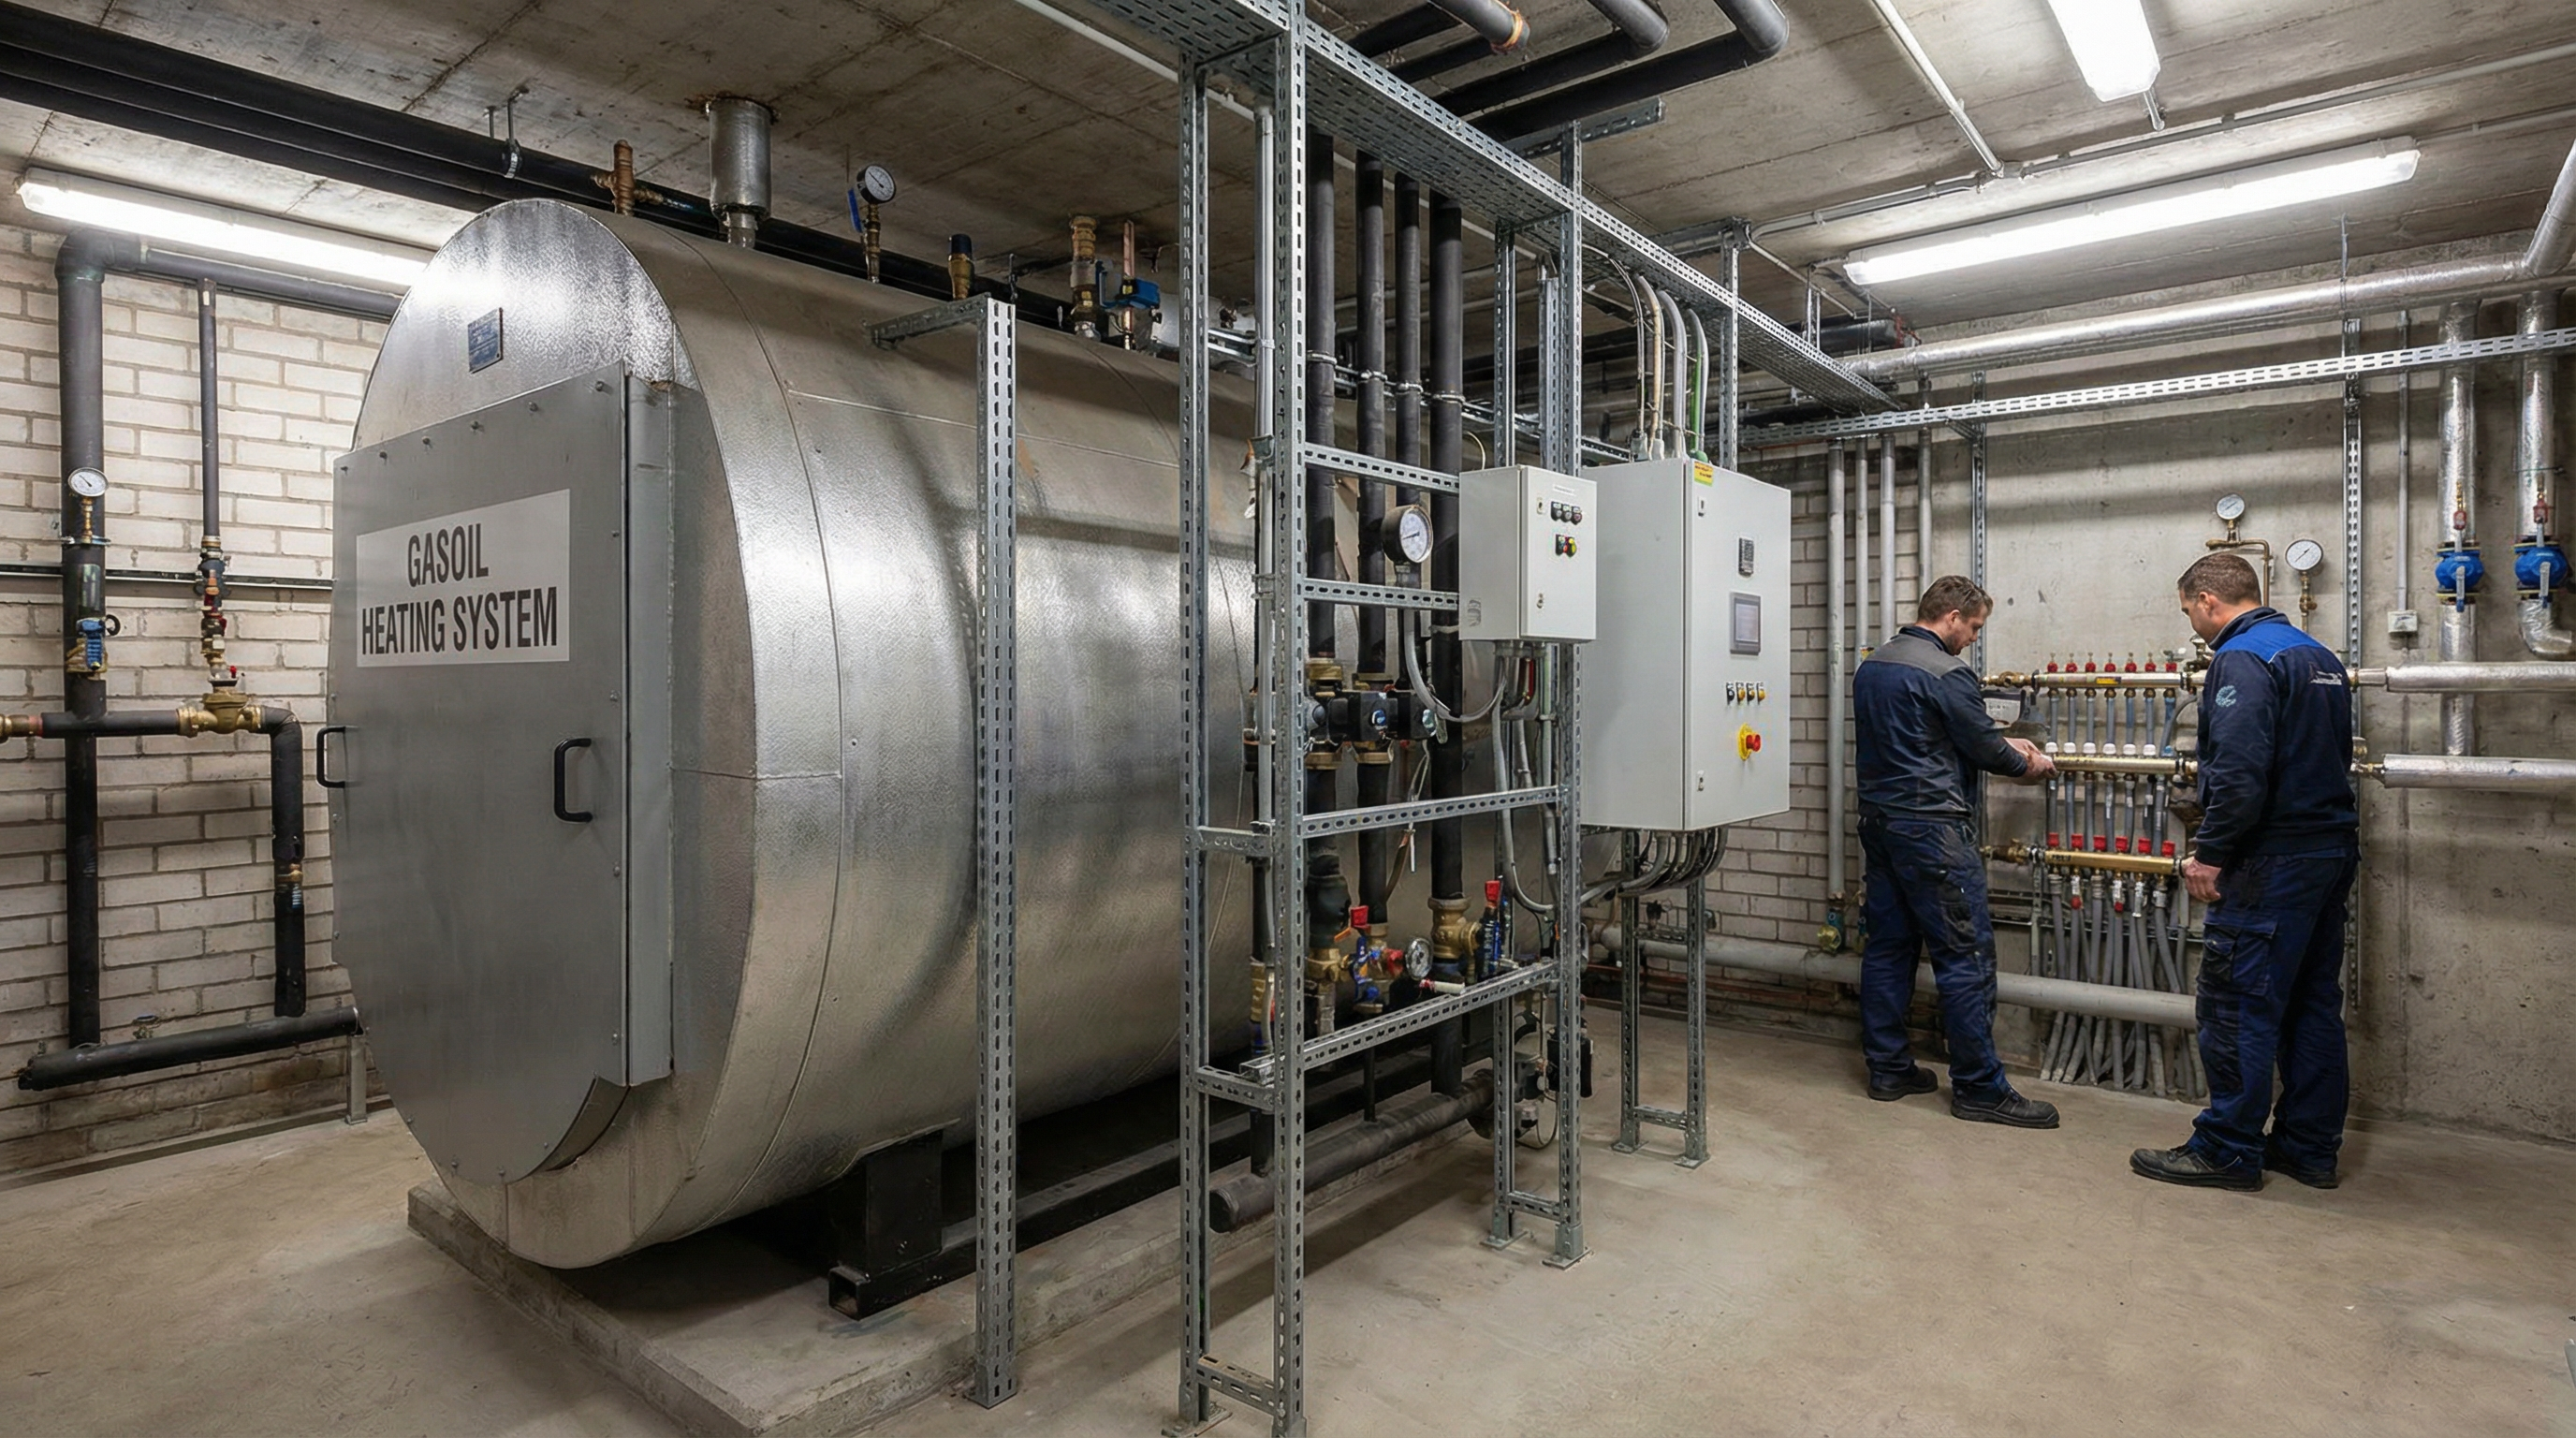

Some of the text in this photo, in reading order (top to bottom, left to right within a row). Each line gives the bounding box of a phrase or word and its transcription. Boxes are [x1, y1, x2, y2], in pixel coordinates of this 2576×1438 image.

[408, 523, 489, 587] GASOIL
[362, 586, 557, 655] HEATING SYSTEM
